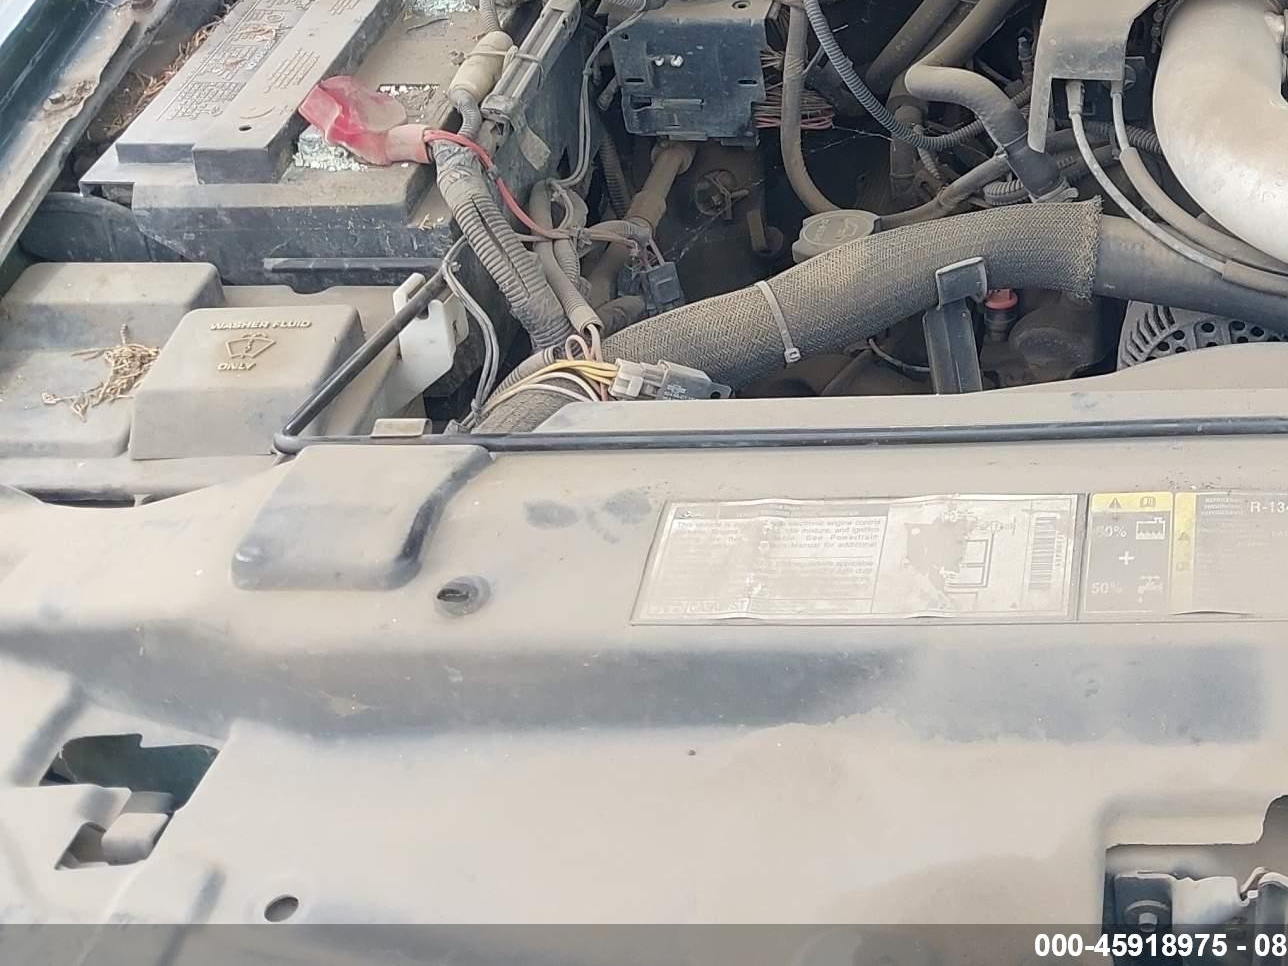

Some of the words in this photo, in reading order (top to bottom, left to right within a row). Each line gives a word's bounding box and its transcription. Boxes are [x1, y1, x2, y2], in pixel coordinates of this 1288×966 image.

[209, 321, 270, 330] WASHER
[271, 319, 313, 330] FLUID
[216, 361, 256, 371] ONLY
[1090, 582, 1123, 594] 50%
